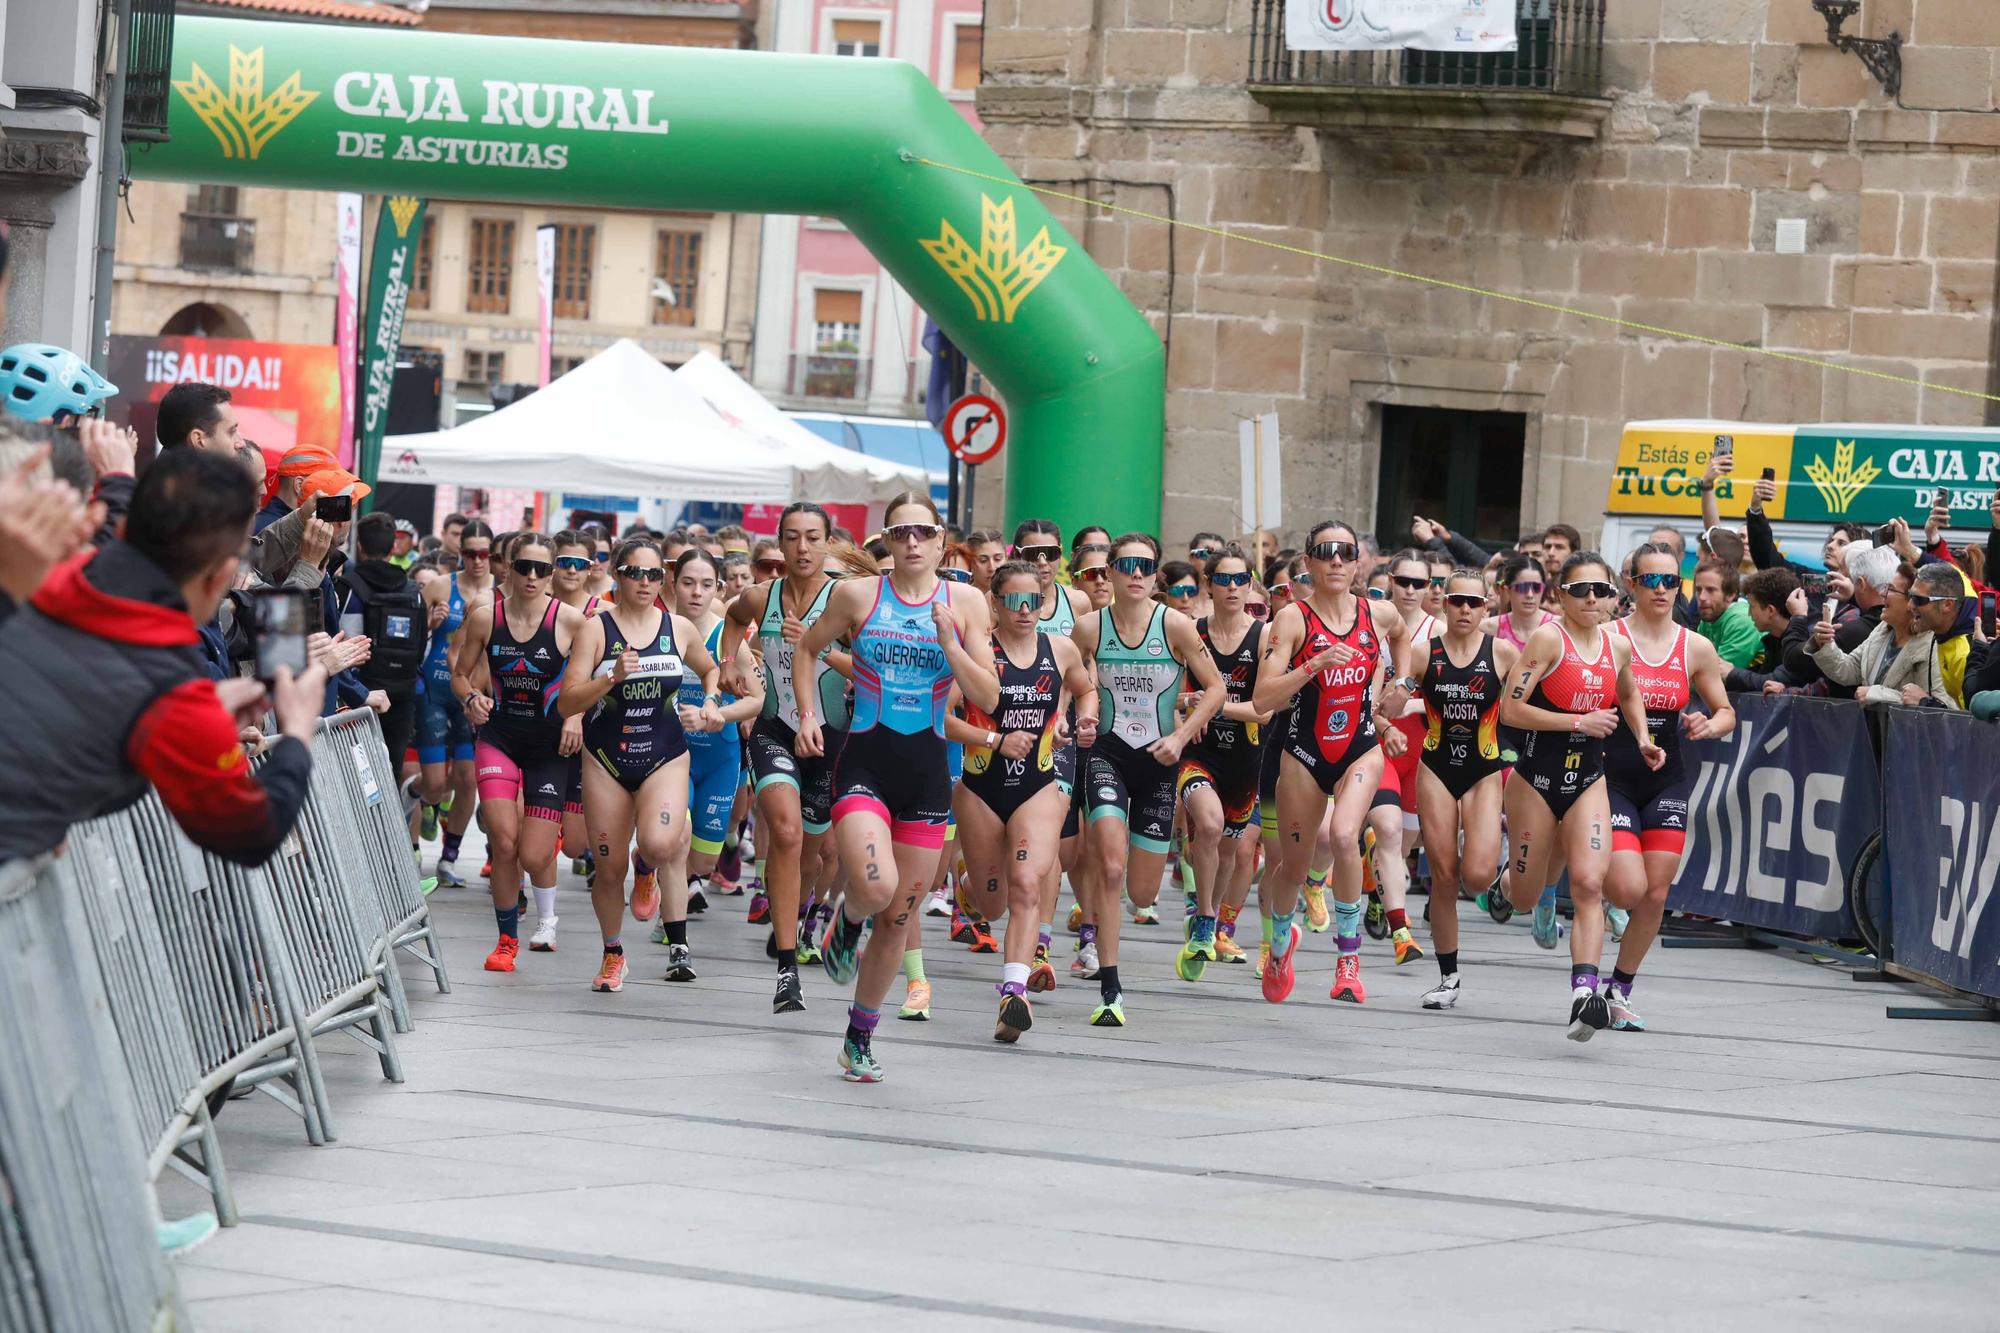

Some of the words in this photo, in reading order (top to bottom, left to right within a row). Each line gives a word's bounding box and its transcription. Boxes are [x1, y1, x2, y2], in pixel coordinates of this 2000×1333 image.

[333, 71, 469, 124] CAJA
[481, 80, 669, 134] RURAL
[336, 131, 386, 159] DE
[392, 135, 568, 169] ASTURIAS
[365, 357, 385, 432] CAJA
[376, 245, 407, 352] RURAL
[385, 283, 409, 381] ASTURIAS
[146, 350, 281, 390] ¡¡SALIDA!!
[1637, 443, 1689, 464] Estás
[1888, 448, 1969, 482] CAJA
[1617, 466, 1654, 496] Tu
[1660, 467, 1734, 499] Caa
[1915, 489, 1939, 509] D
[874, 642, 944, 671] GUERRERO
[502, 676, 540, 691] NAVARRO
[1114, 676, 1154, 693] PEIRATS
[1324, 666, 1366, 687] VARO
[622, 677, 661, 700] GARCÍA
[1123, 696, 1137, 704] ITV
[1570, 689, 1604, 710] MUÑOZ
[625, 707, 653, 717] MAPEI
[1001, 708, 1046, 729] AROSTEGUI
[1443, 704, 1478, 721] ACOSTA
[660, 811, 670, 825] 9
[598, 844, 609, 857] 9
[1016, 849, 1028, 861] 8
[987, 878, 998, 892] 8
